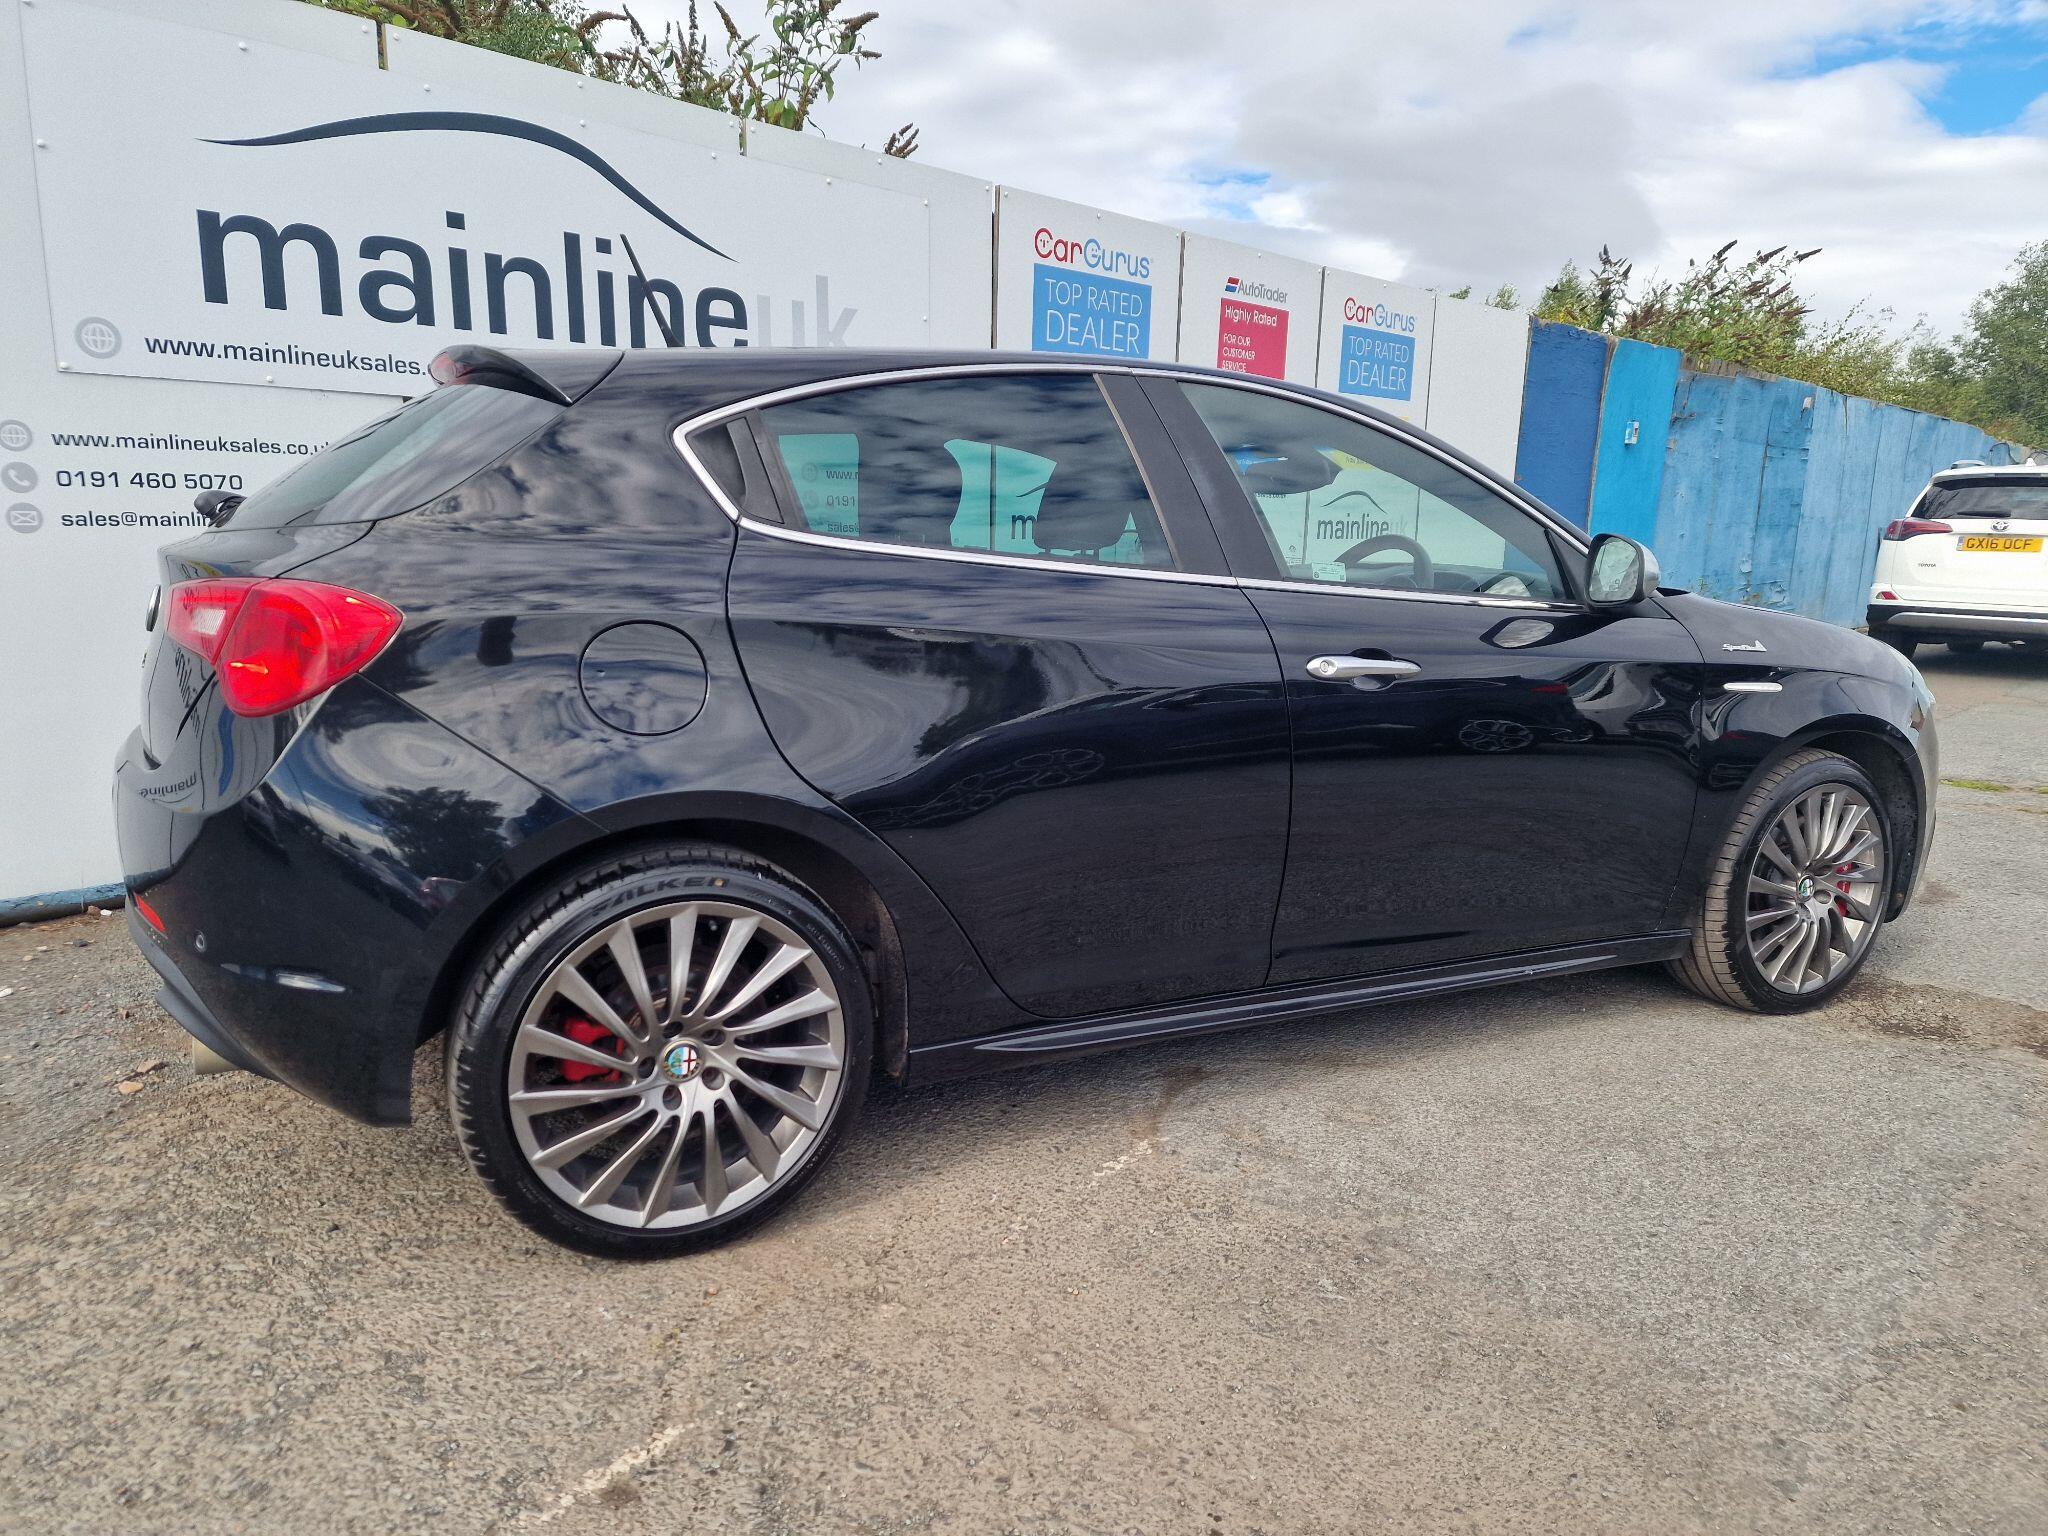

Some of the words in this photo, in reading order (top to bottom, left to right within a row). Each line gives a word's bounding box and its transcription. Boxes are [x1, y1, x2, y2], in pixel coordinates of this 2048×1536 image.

[1034, 227, 1150, 279] CarGurus
[1045, 278, 1082, 306] TOP
[1088, 286, 1143, 317] RATED
[1238, 280, 1288, 303] AutoTrader
[1225, 305, 1252, 324] Highly
[1253, 310, 1277, 326] Rated
[1344, 297, 1416, 332] CarGurus
[1046, 309, 1140, 354] DEALER
[1223, 333, 1236, 344] FOR
[1238, 335, 1251, 346] OUR
[144, 336, 431, 376] www.mainlineuksales.
[1349, 335, 1372, 356] TOP
[1375, 340, 1409, 362] RATED
[1348, 359, 1407, 391] DEALER
[56, 470, 120, 488] 0191
[129, 471, 177, 489] 460
[184, 473, 243, 490] 5070
[827, 495, 855, 507] 0191
[1966, 537, 1999, 550] GX16
[2003, 538, 2034, 550] OCF
